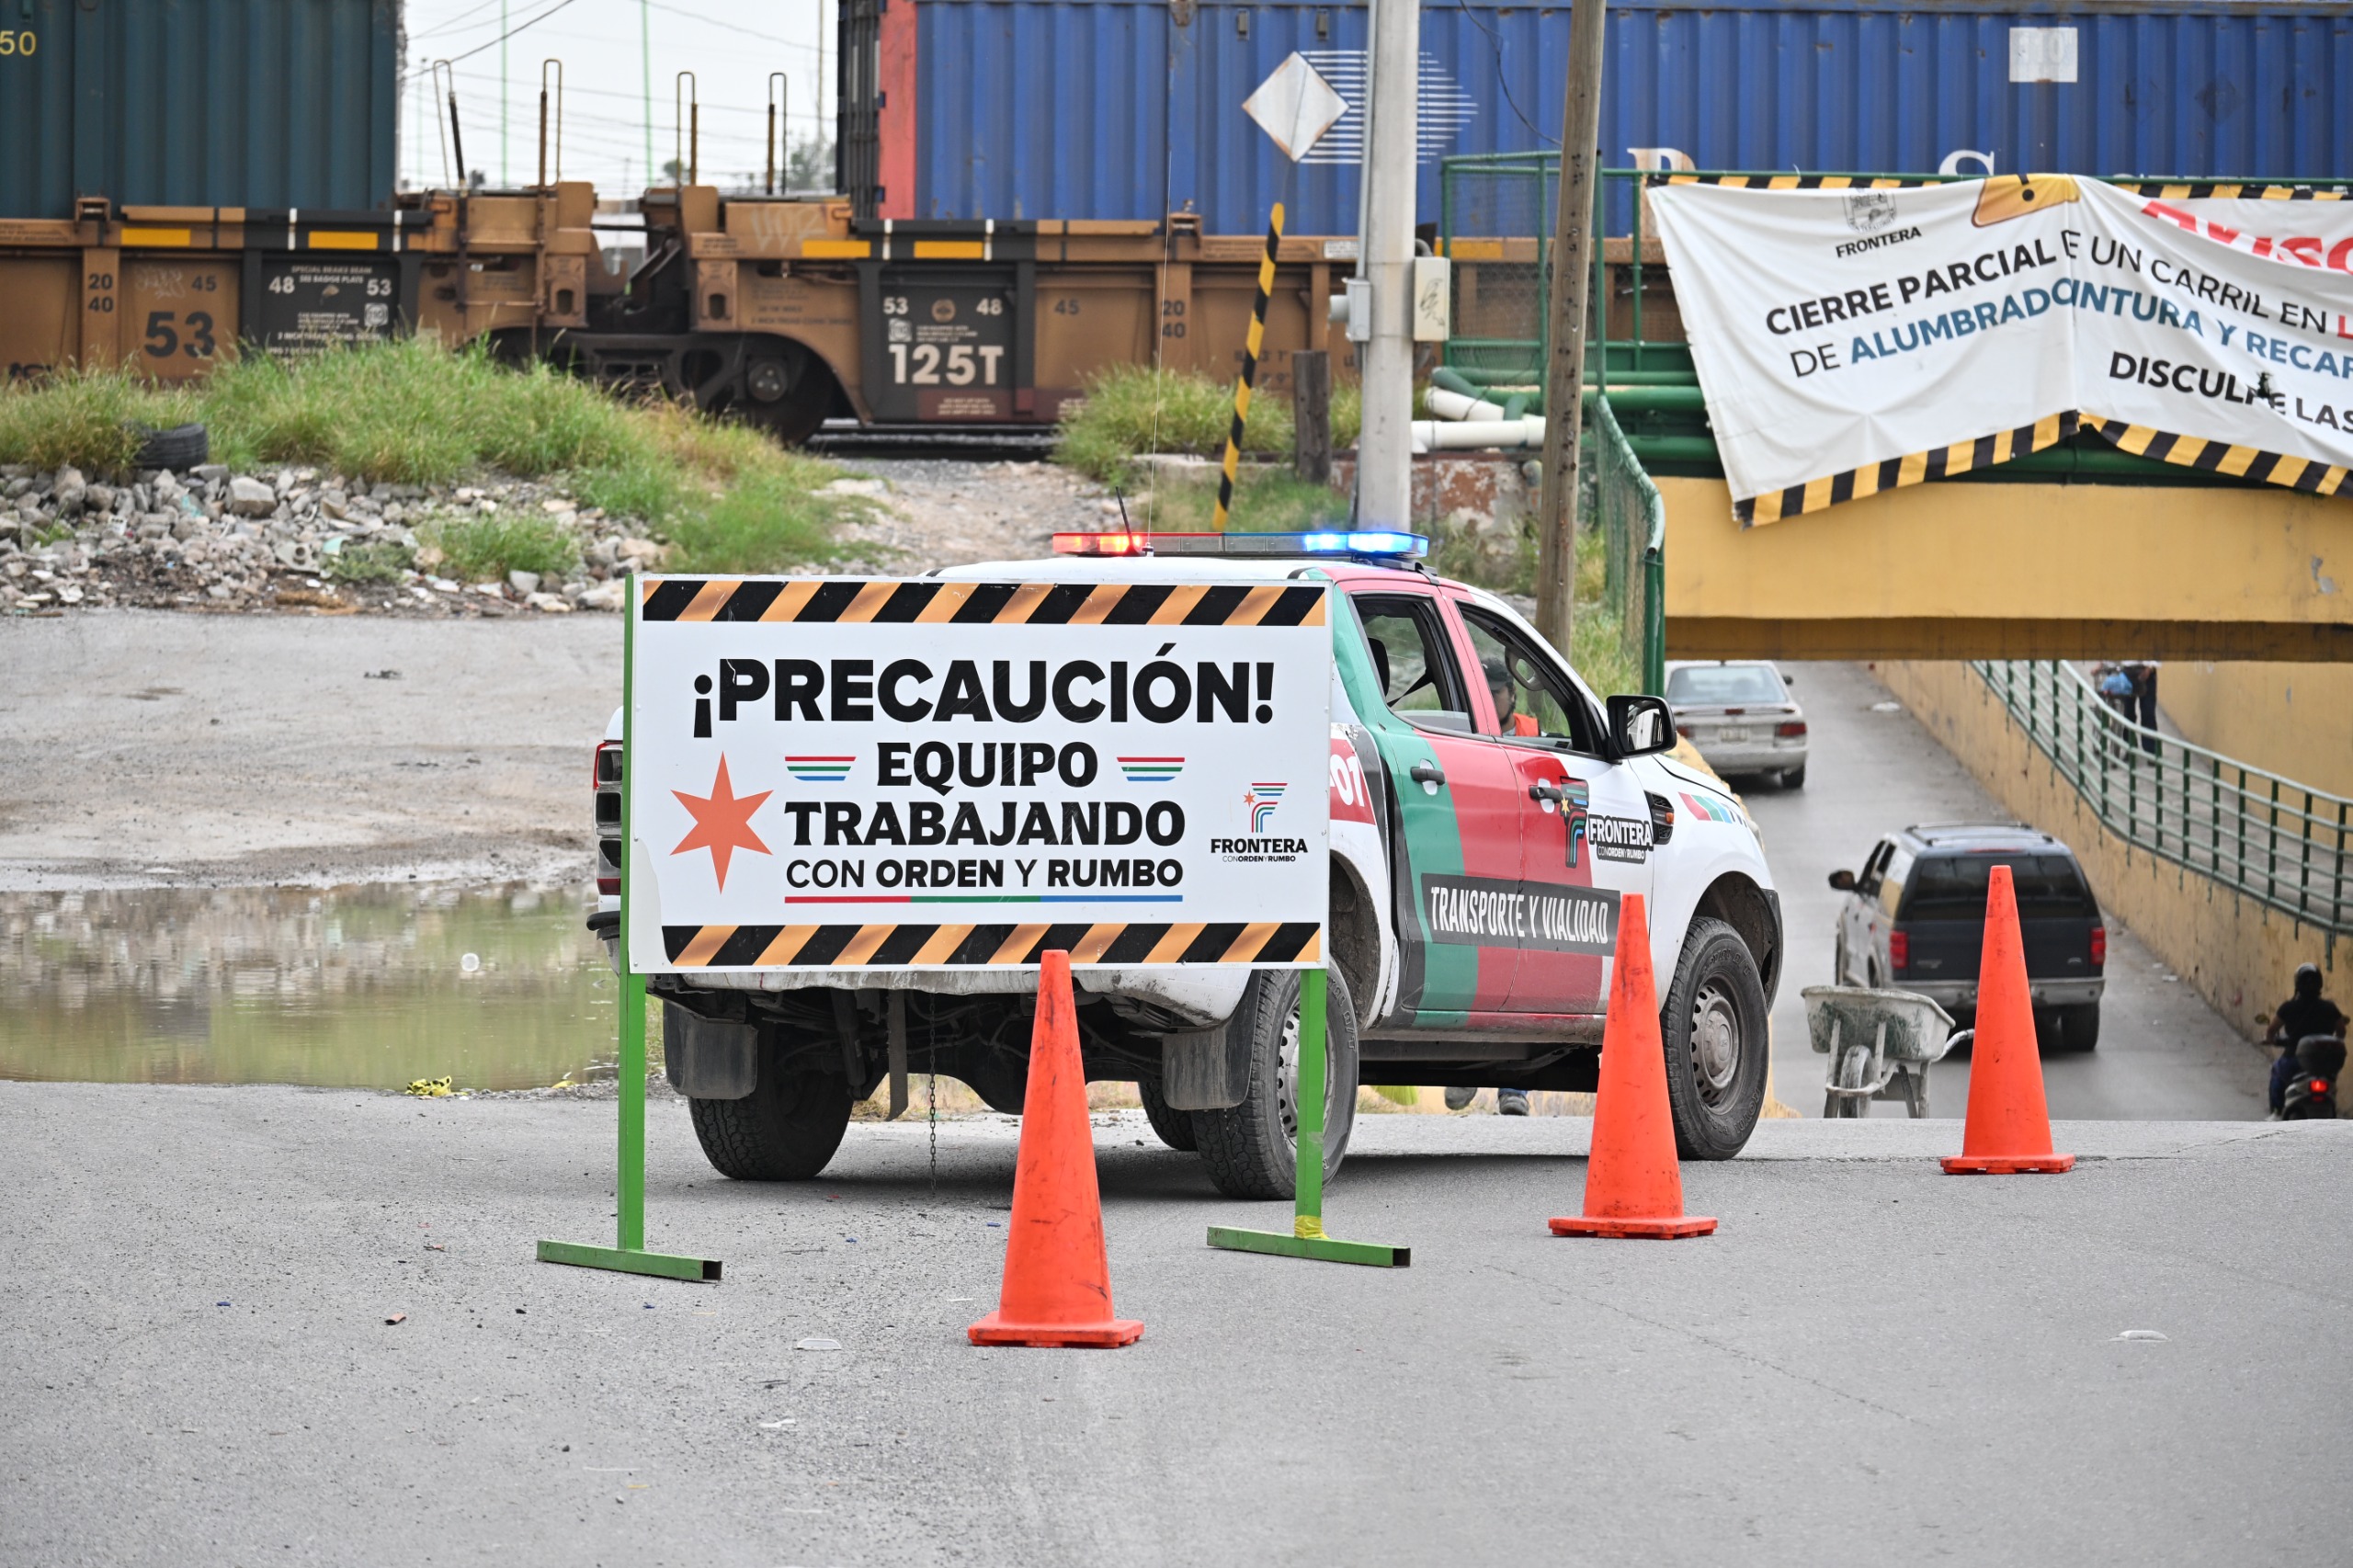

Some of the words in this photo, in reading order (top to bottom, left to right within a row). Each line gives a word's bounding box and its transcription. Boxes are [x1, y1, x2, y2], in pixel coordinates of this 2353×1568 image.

[1836, 226, 1923, 258] FRONTERA
[88, 274, 113, 290] 20
[191, 275, 217, 292] 45
[268, 276, 295, 294] 48
[367, 278, 392, 296] 53
[1766, 283, 1893, 335] CIERRE
[1900, 237, 2056, 305] PARCIAL
[2091, 235, 2142, 272] UN
[2151, 259, 2269, 319] CARRIL
[2279, 302, 2326, 334] EN
[88, 296, 114, 313] 40
[883, 297, 908, 314] 53
[976, 298, 1003, 315] 48
[1054, 299, 1080, 315] 45
[1162, 300, 1185, 316] 20
[143, 311, 216, 358] 53
[1161, 323, 1186, 338] 40
[1790, 343, 1841, 378] DE
[1850, 278, 2074, 365] ALUMBRADO
[2216, 318, 2238, 347] Y
[889, 344, 1004, 385] 125T
[693, 642, 1275, 738] ¡PRECAUCIÓN!
[876, 741, 1098, 797] EQUIPO
[784, 800, 1186, 846] TRABAJANDO
[1589, 817, 1653, 846] FRONTERA
[1211, 837, 1309, 854] FRONTERA
[786, 858, 866, 889] CON
[875, 858, 1005, 889] ORDEN
[1011, 859, 1038, 888] Y
[1047, 858, 1184, 889] RUMBO
[1431, 886, 1526, 937] TRANSPORTE
[1529, 895, 1540, 938] Y
[1542, 896, 1608, 945] VIALIDAD
